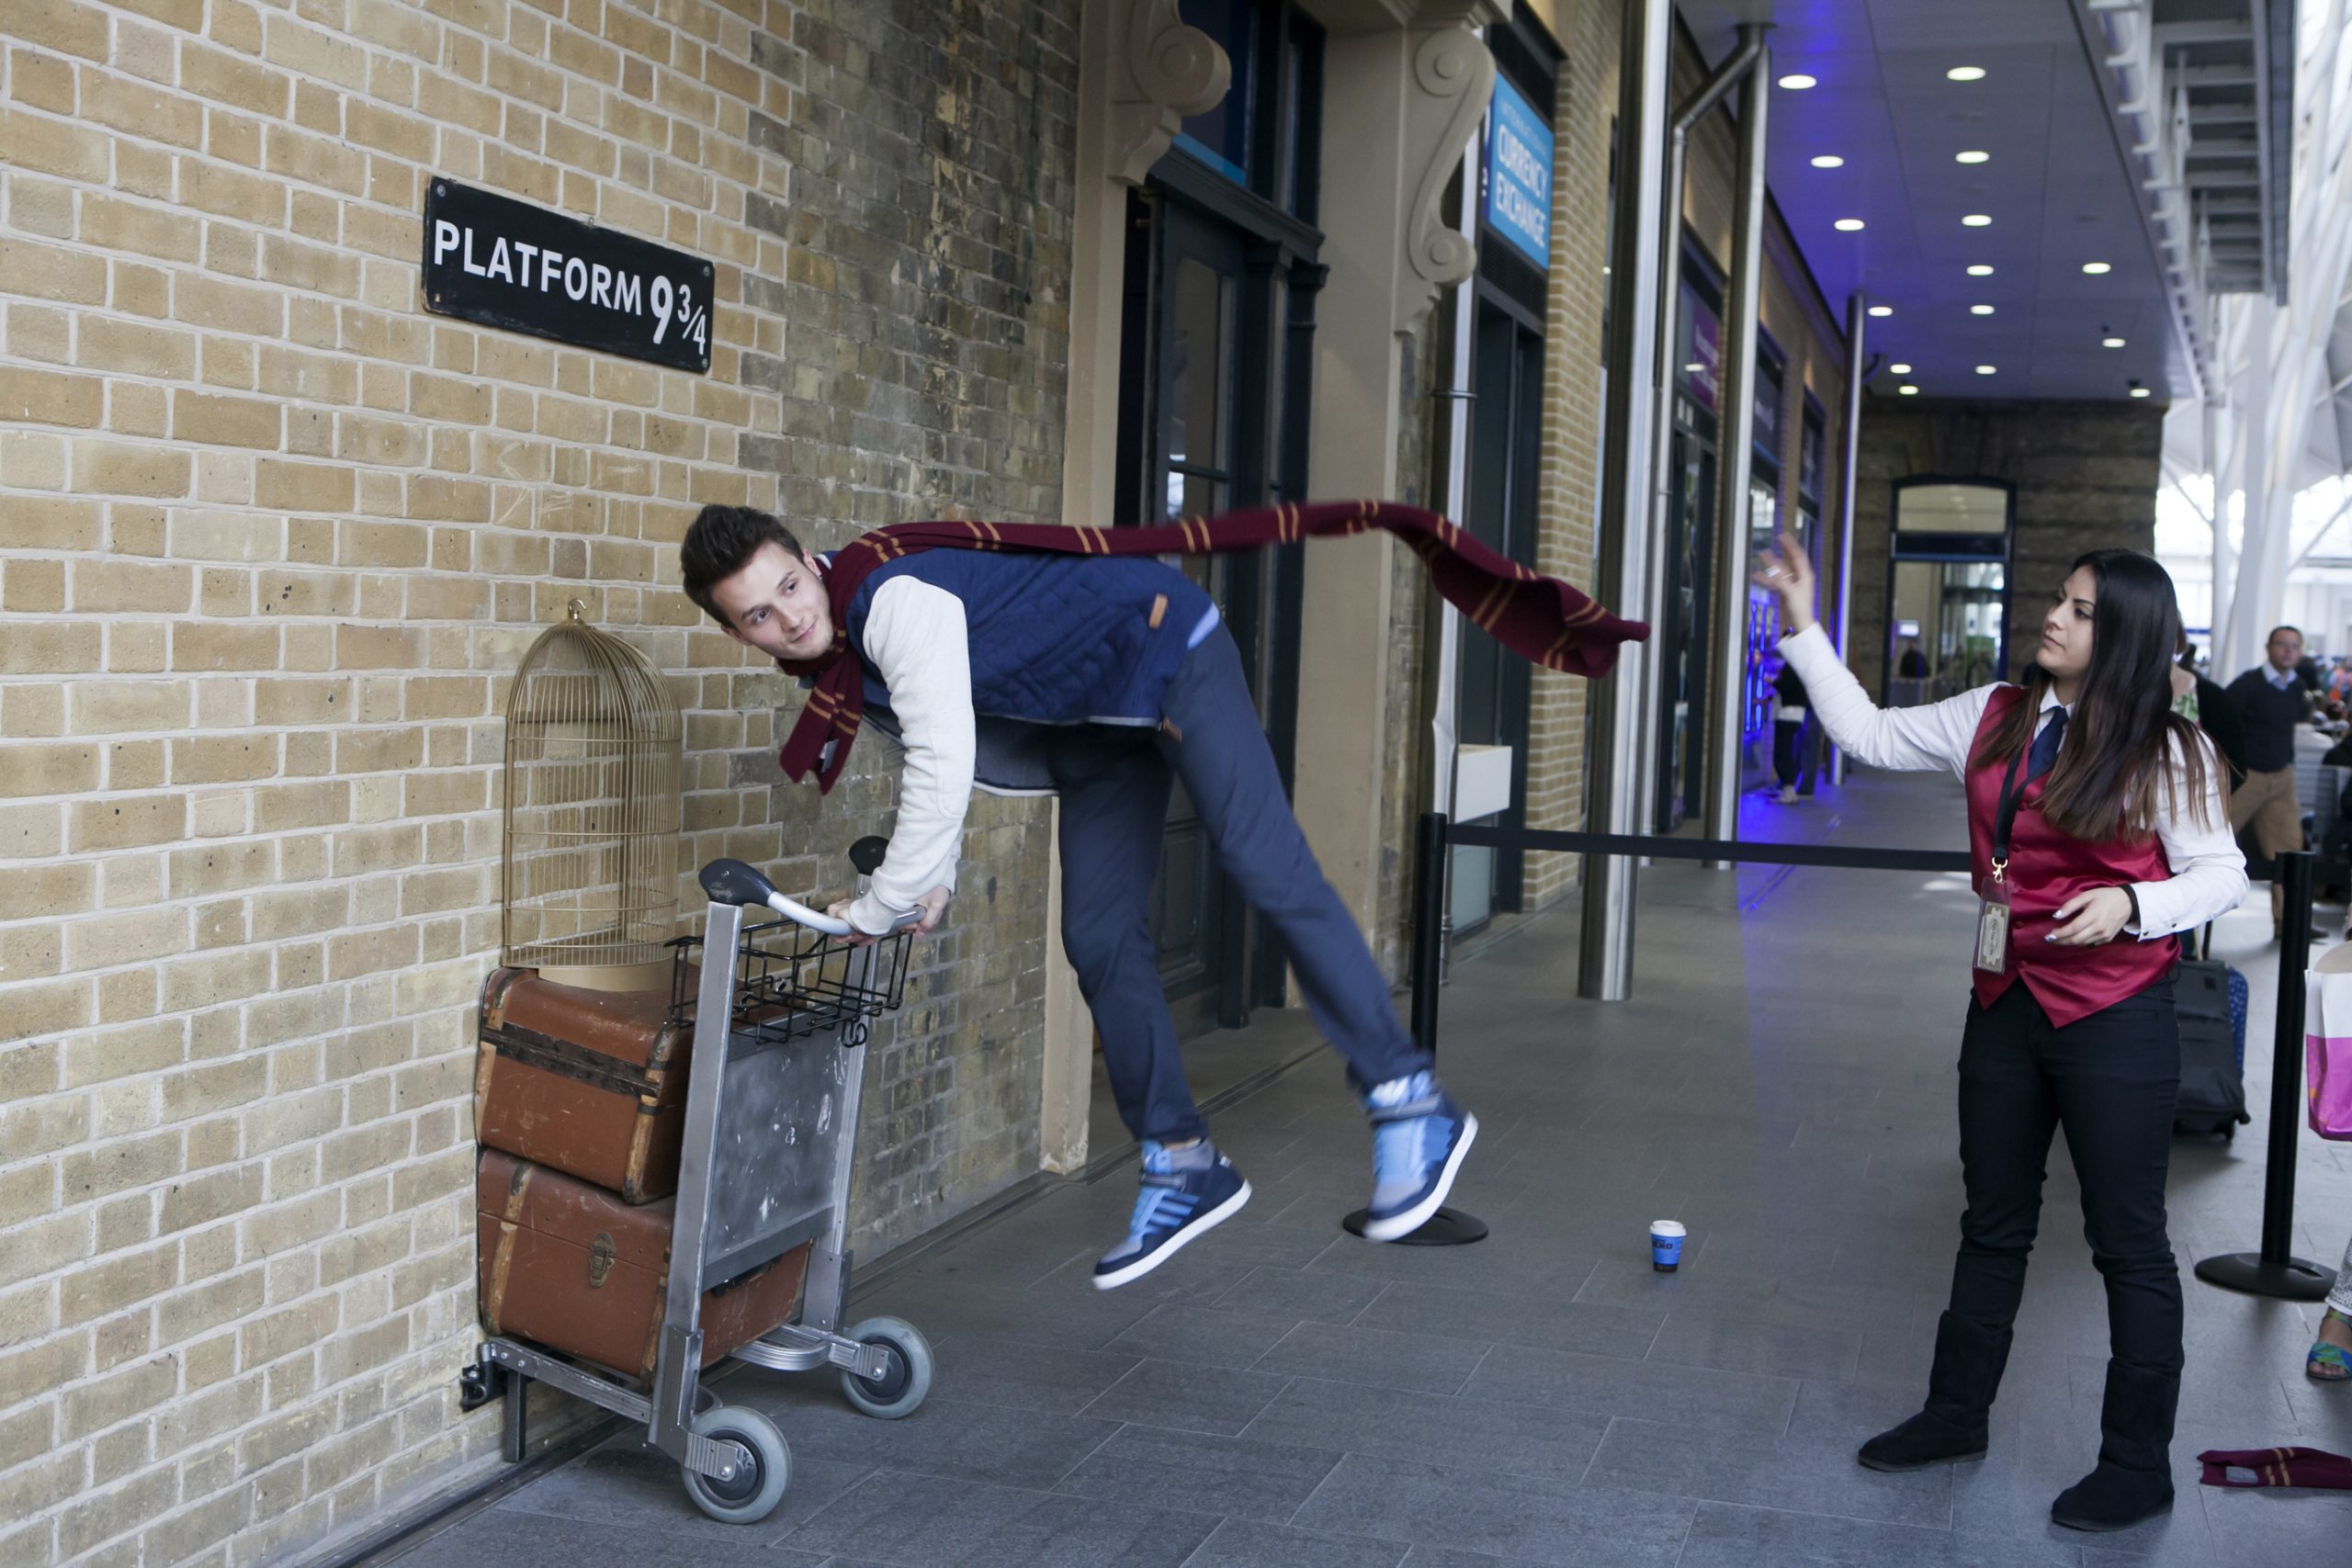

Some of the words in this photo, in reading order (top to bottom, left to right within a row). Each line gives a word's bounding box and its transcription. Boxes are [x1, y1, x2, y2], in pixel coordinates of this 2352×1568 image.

[1498, 123, 1548, 202] CURRENCY
[1496, 171, 1546, 249] EXCHANGE
[434, 219, 642, 315] PLATFORM
